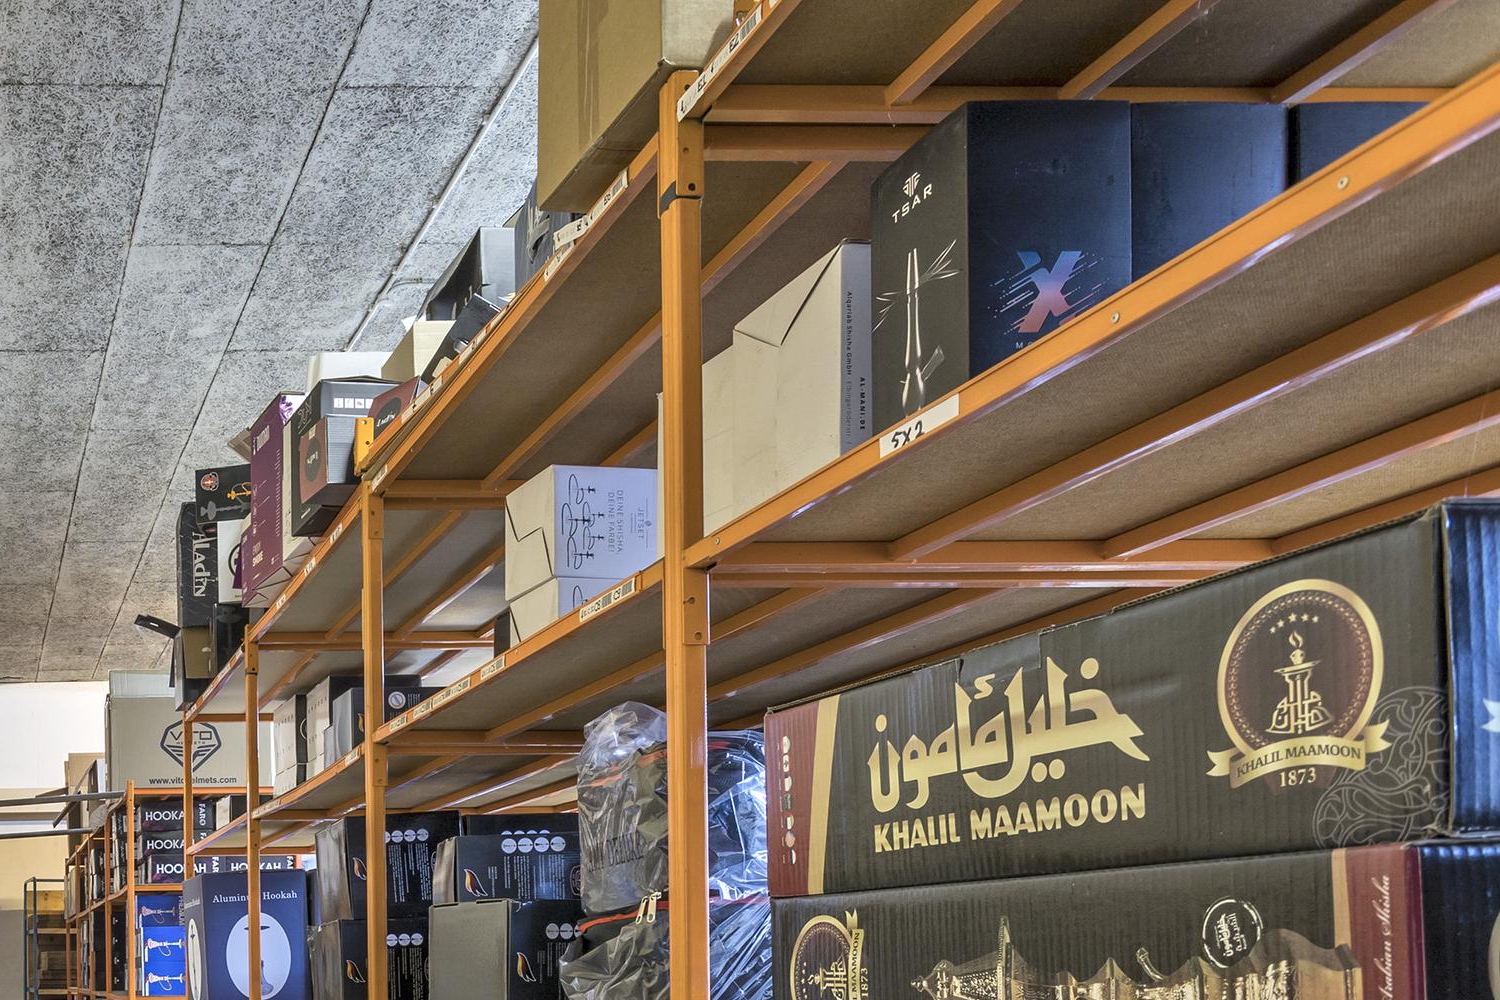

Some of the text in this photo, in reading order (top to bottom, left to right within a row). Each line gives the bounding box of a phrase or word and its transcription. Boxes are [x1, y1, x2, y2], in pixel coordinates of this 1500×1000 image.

[892, 182, 933, 224] TSAR
[1236, 743, 1361, 778] KHALIL MAAMOON
[1279, 767, 1316, 787] 1873
[145, 811, 185, 821] HOOKA
[873, 783, 1147, 854] KHALIL MAAMOON
[147, 840, 194, 849] HOOKA
[156, 863, 206, 874] HOOAH
[231, 862, 281, 870] HOKAH
[212, 891, 298, 903] Alumin Hookah
[1372, 875, 1392, 936] Shisha
[851, 932, 860, 992] MAAMOON
[861, 967, 869, 998] 1873
